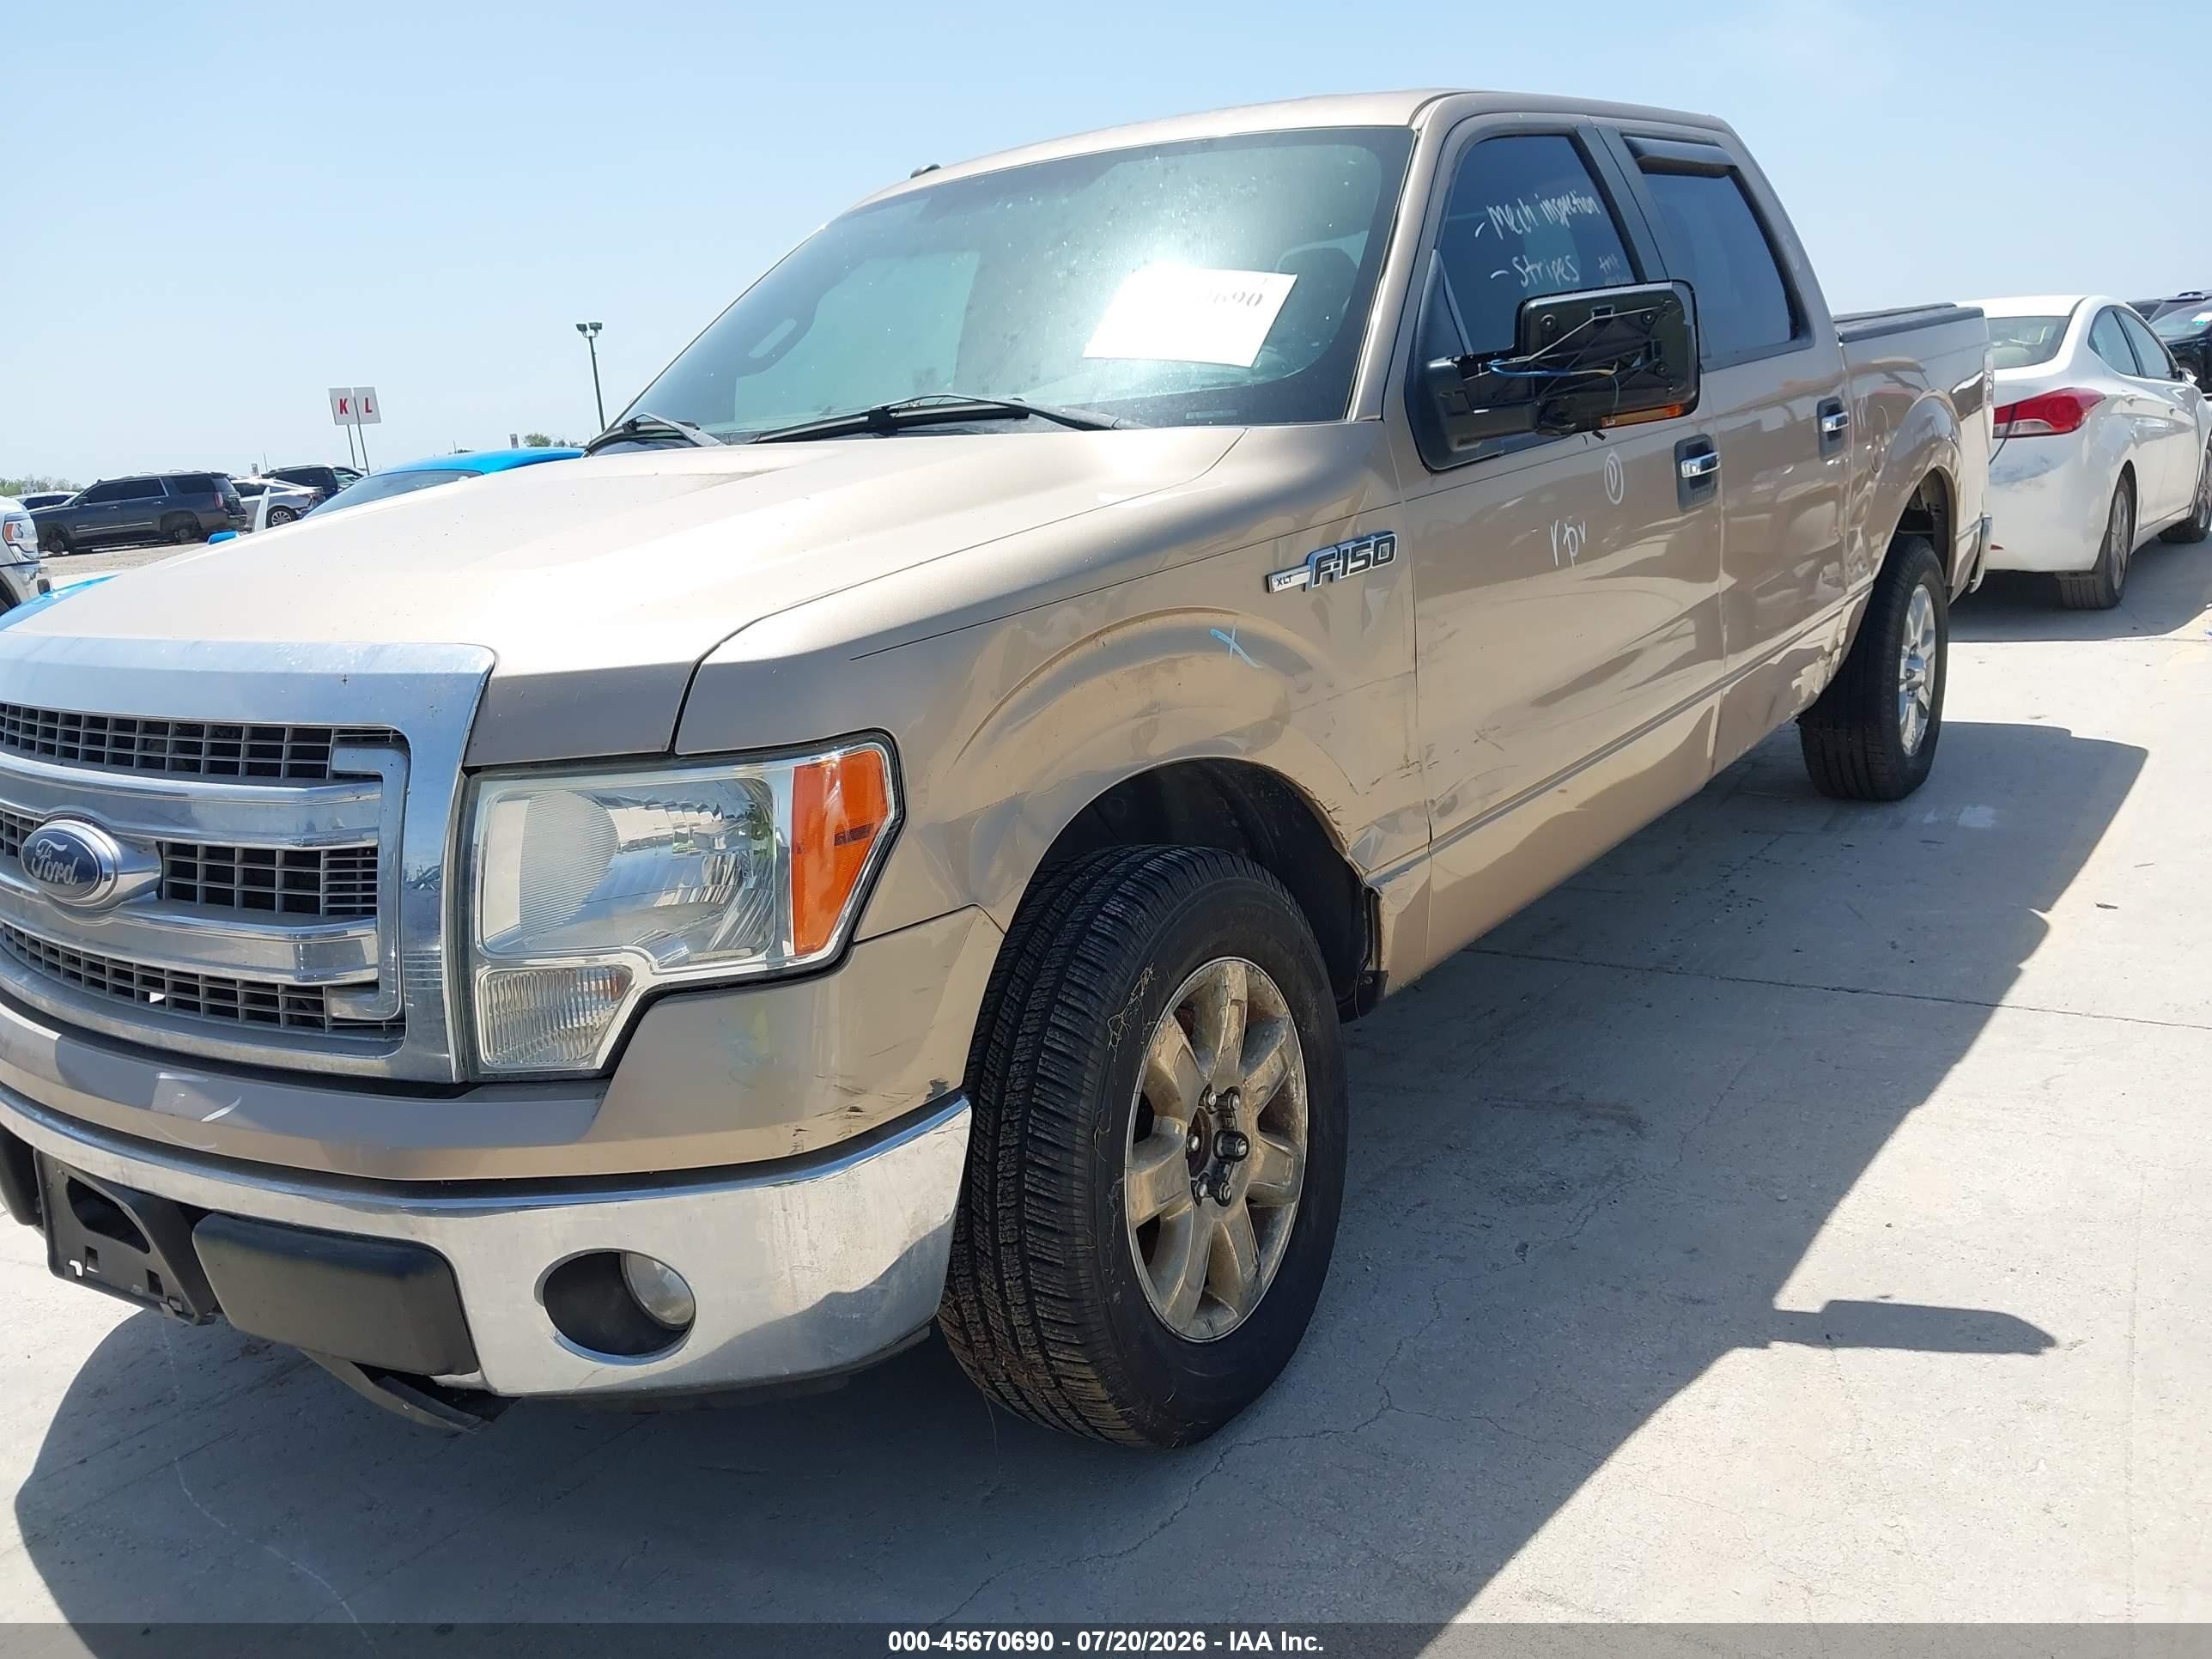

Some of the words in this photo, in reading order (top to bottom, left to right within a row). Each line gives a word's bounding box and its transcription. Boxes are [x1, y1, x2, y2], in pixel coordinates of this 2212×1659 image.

[1486, 198, 1539, 240] Mech
[339, 398, 349, 415] K
[364, 397, 373, 413] L
[1276, 574, 1292, 586] XLT
[1311, 533, 1398, 588] F-150
[30, 838, 79, 886] Ford
